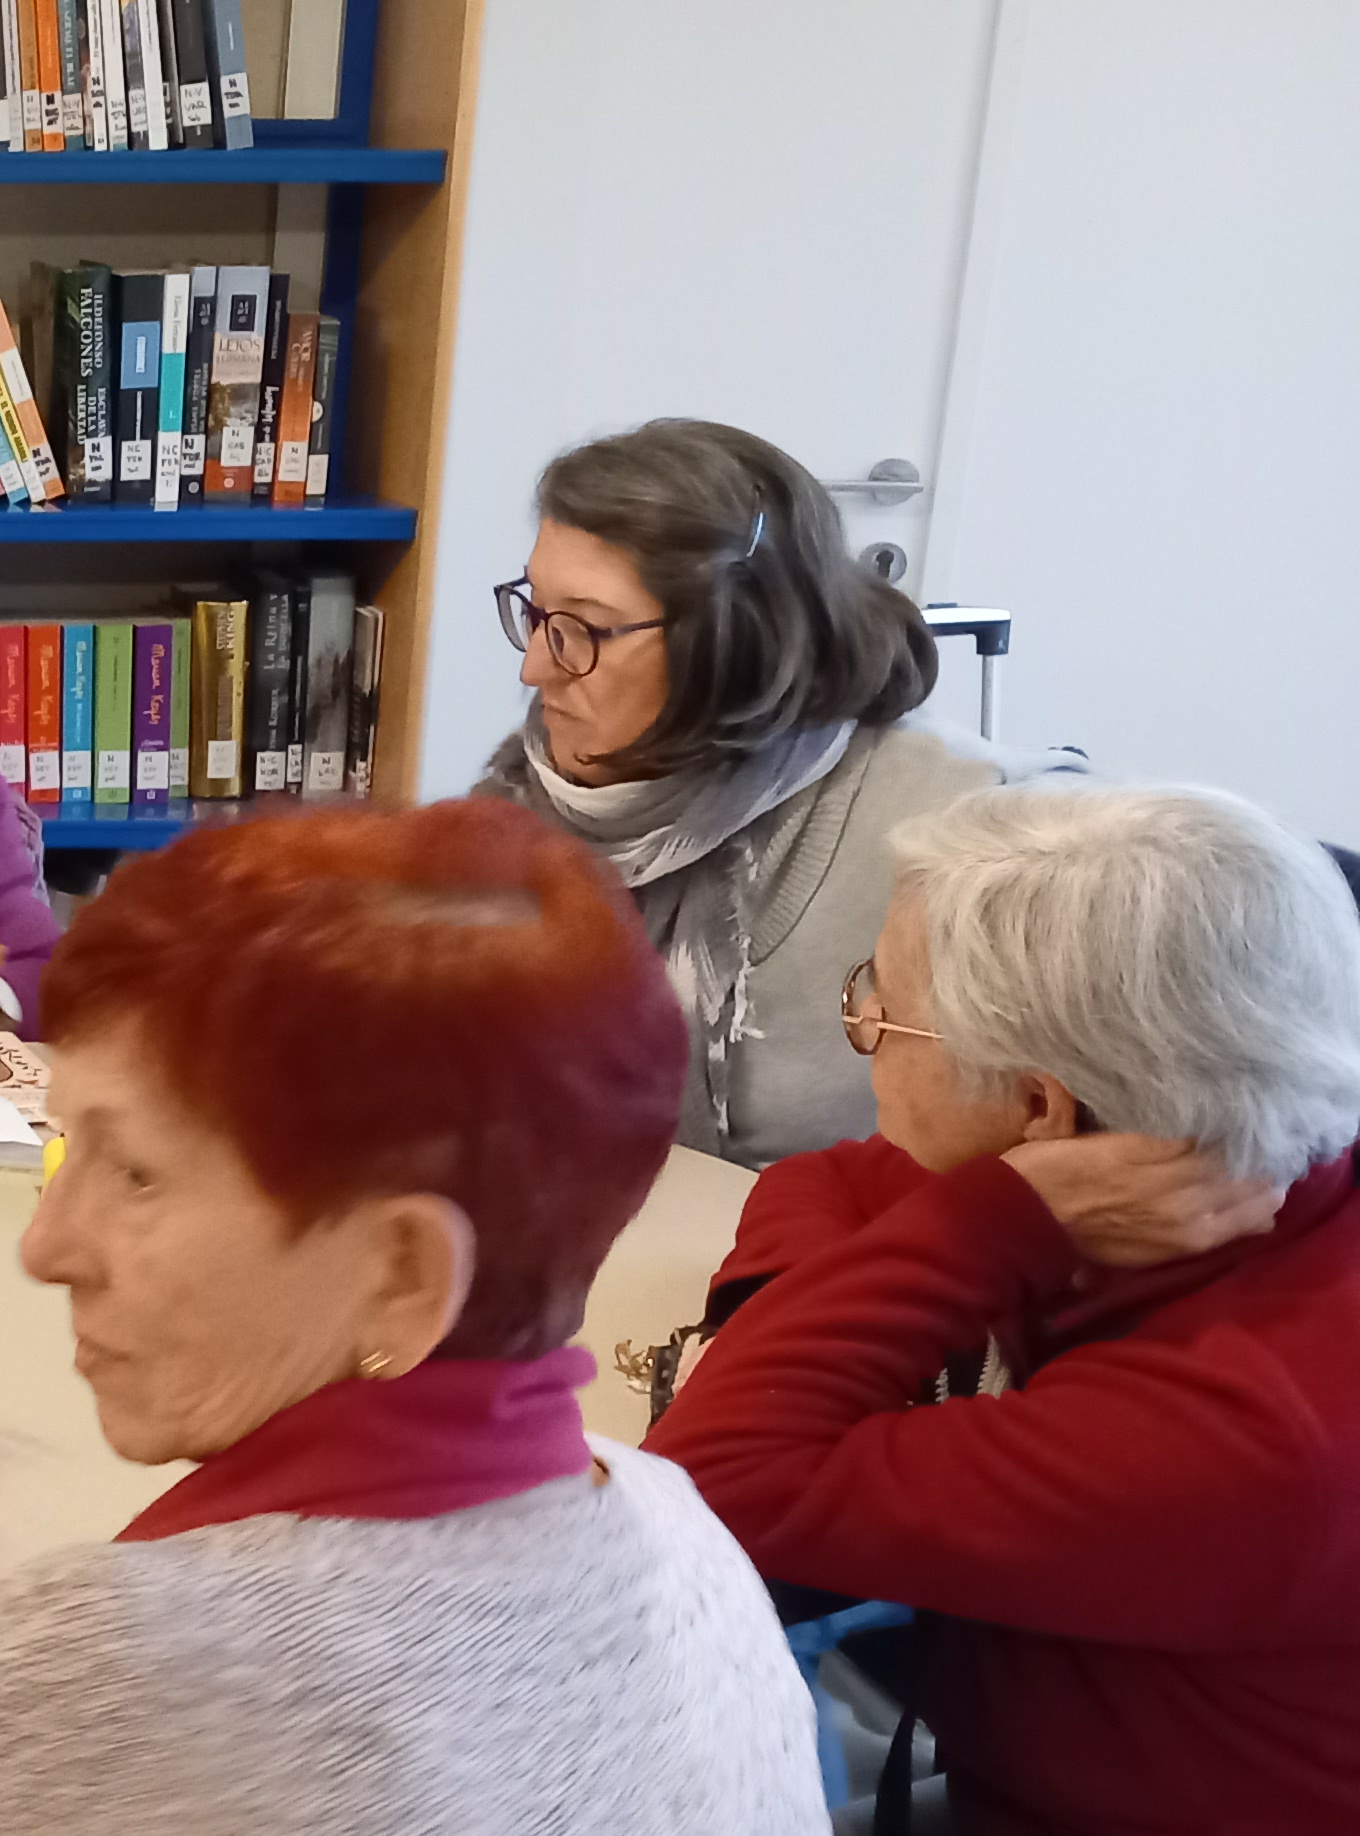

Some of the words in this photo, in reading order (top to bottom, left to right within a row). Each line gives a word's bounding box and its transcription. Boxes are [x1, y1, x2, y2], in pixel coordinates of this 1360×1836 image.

[80, 287, 94, 378] FALCONES
[93, 294, 104, 369] ILDEFONSO
[226, 609, 236, 650] KING
